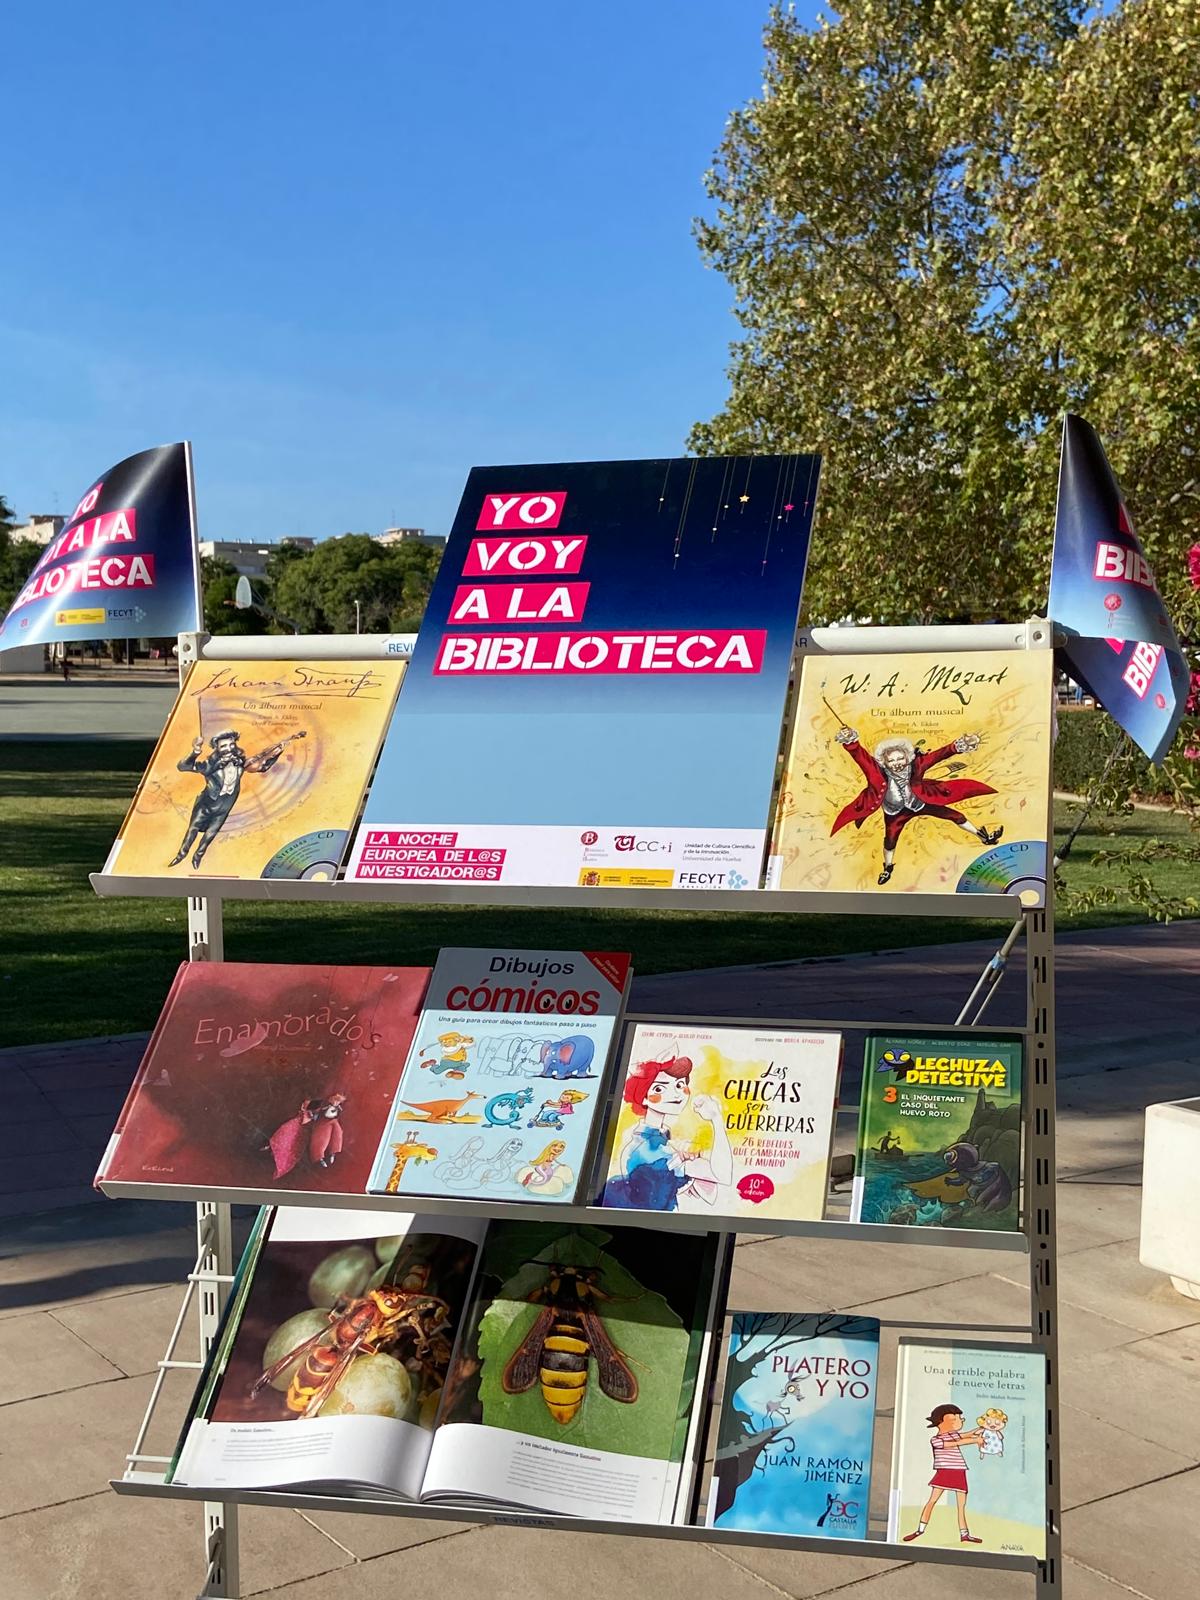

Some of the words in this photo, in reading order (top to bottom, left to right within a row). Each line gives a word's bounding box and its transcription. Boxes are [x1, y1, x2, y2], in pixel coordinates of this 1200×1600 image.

[490, 495, 556, 526] YO
[92, 511, 133, 551] LA
[476, 539, 584, 571] VOY
[454, 588, 490, 619] A
[506, 586, 575, 618] LA
[107, 608, 135, 618] FECYT
[438, 634, 754, 671] BIBLIOTECA
[920, 664, 1009, 706] Mozart
[243, 702, 257, 710] Un
[289, 701, 323, 710] musical
[870, 708, 886, 717] Un
[889, 707, 922, 717] álbum
[925, 706, 965, 716] musical
[317, 831, 335, 840] CD
[368, 833, 390, 846] LA
[397, 833, 454, 847] NOCHE
[364, 849, 437, 862] EUROPEA
[443, 849, 464, 862] DE
[468, 850, 502, 863] L@S
[967, 851, 1001, 878] Mozart
[1009, 843, 1030, 853] CD
[359, 865, 498, 879] INVESTIGADOR@S
[679, 872, 727, 885] FECYT
[488, 956, 575, 978] Dibujos
[445, 978, 601, 1016] cómicos
[194, 1005, 382, 1050] Enamorados
[499, 1018, 523, 1026] dibujos
[580, 1021, 597, 1029] paso
[760, 1060, 789, 1081] Las
[914, 1056, 1007, 1074] LECHUZA
[905, 1069, 1006, 1088] DETECTIVE
[723, 1079, 802, 1104] CHICAS
[883, 1086, 897, 1104] 3
[913, 1094, 966, 1103] INQUIETANTE
[742, 1102, 770, 1115] son
[900, 1109, 926, 1117] HUEVO
[928, 1110, 951, 1118] ROTO
[924, 1102, 938, 1110] DEL
[725, 1113, 815, 1135] GUERRERAS
[742, 1136, 755, 1147] 26
[732, 1146, 747, 1157] QUE
[750, 1147, 801, 1160] CAMBIARON
[754, 1158, 786, 1168] MUNDO
[771, 1355, 871, 1378] PLATERO
[923, 1365, 945, 1375] Una
[947, 1367, 986, 1377] terrible
[988, 1368, 1026, 1380] palabra
[815, 1378, 830, 1397] Y
[836, 1379, 870, 1400] YO
[948, 1376, 961, 1387] de
[963, 1381, 995, 1389] nueve
[997, 1380, 1026, 1390] letras
[763, 1454, 801, 1467] JUAN
[806, 1456, 864, 1472] RAMÓN
[803, 1468, 863, 1486] JIMÉNEZ
[1000, 1543, 1025, 1552] ANAYA
